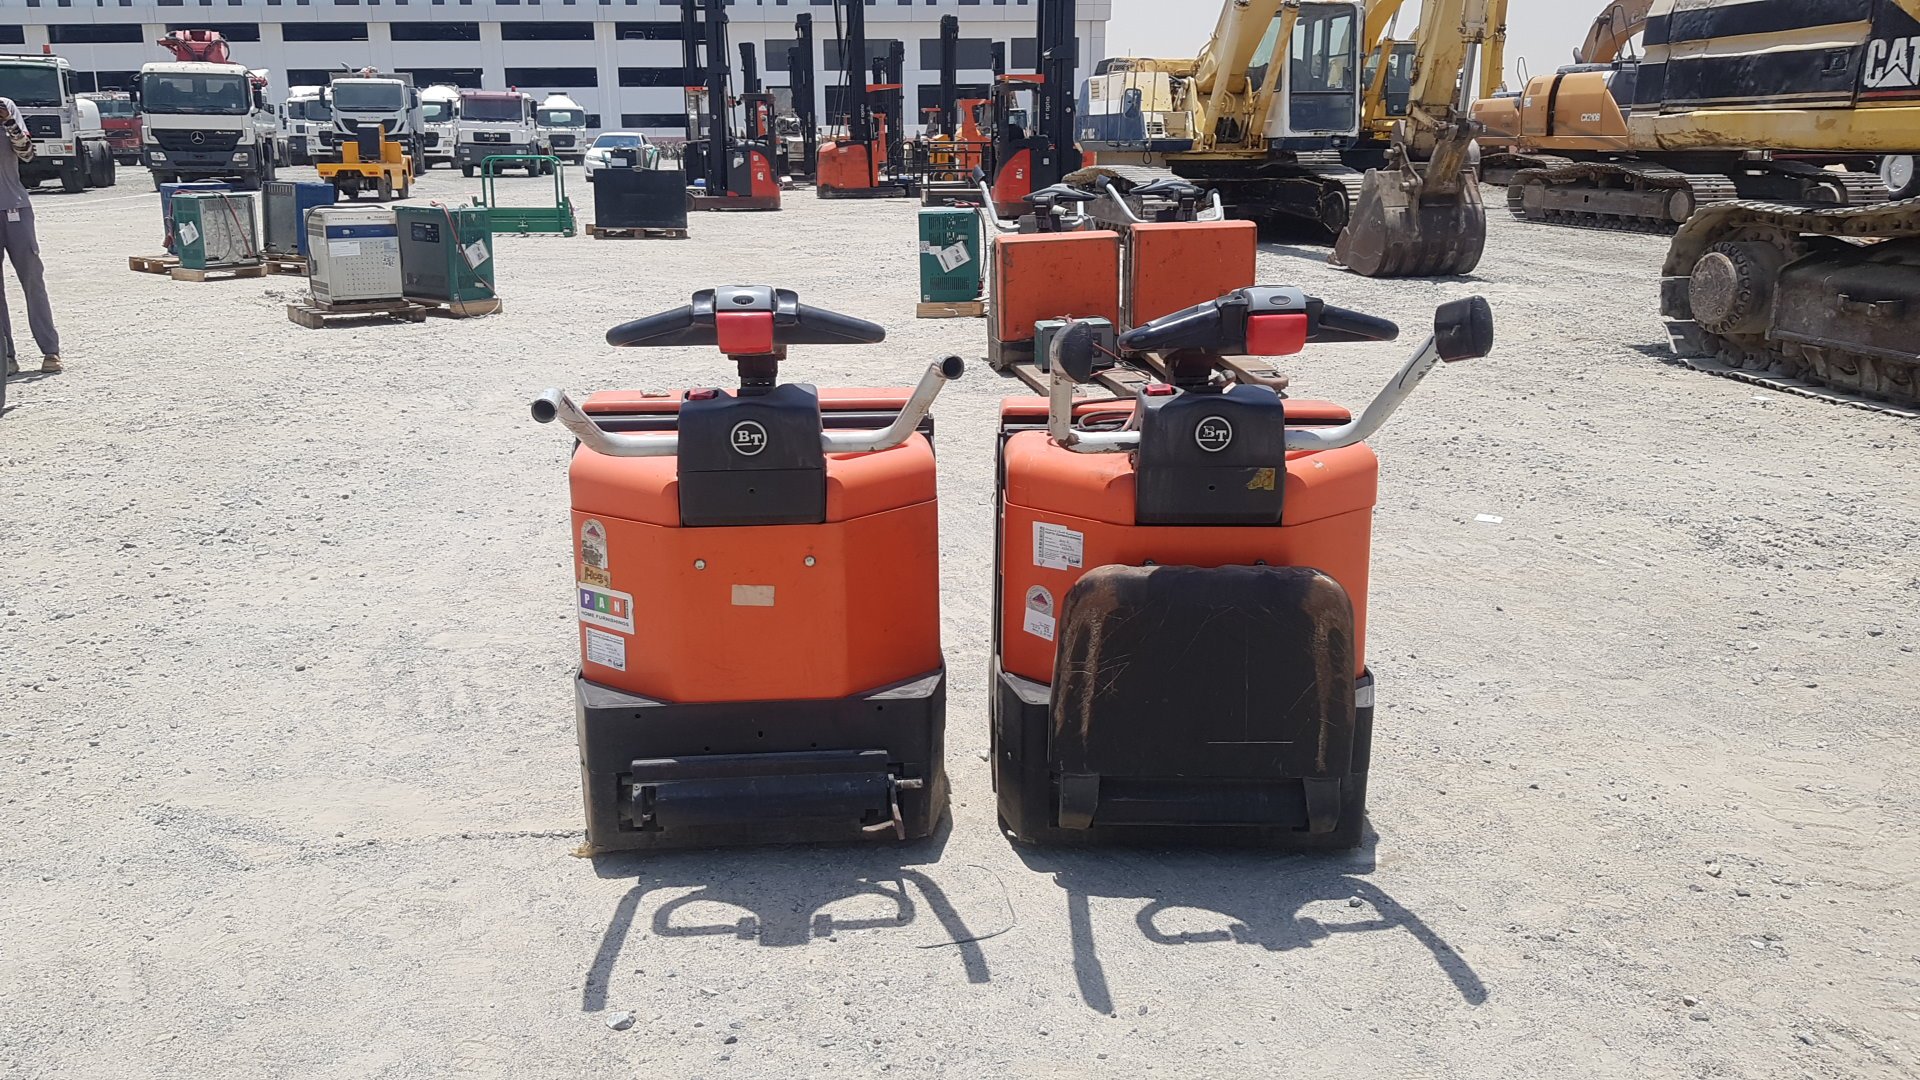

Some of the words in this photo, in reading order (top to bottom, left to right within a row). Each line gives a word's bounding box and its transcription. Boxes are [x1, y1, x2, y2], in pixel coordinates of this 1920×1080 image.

[737, 430, 762, 446] BT
[1202, 425, 1227, 442] BT
[584, 593, 620, 613] PAN
[580, 610, 594, 618] HOME
[595, 614, 629, 627] FURNISHINGS
